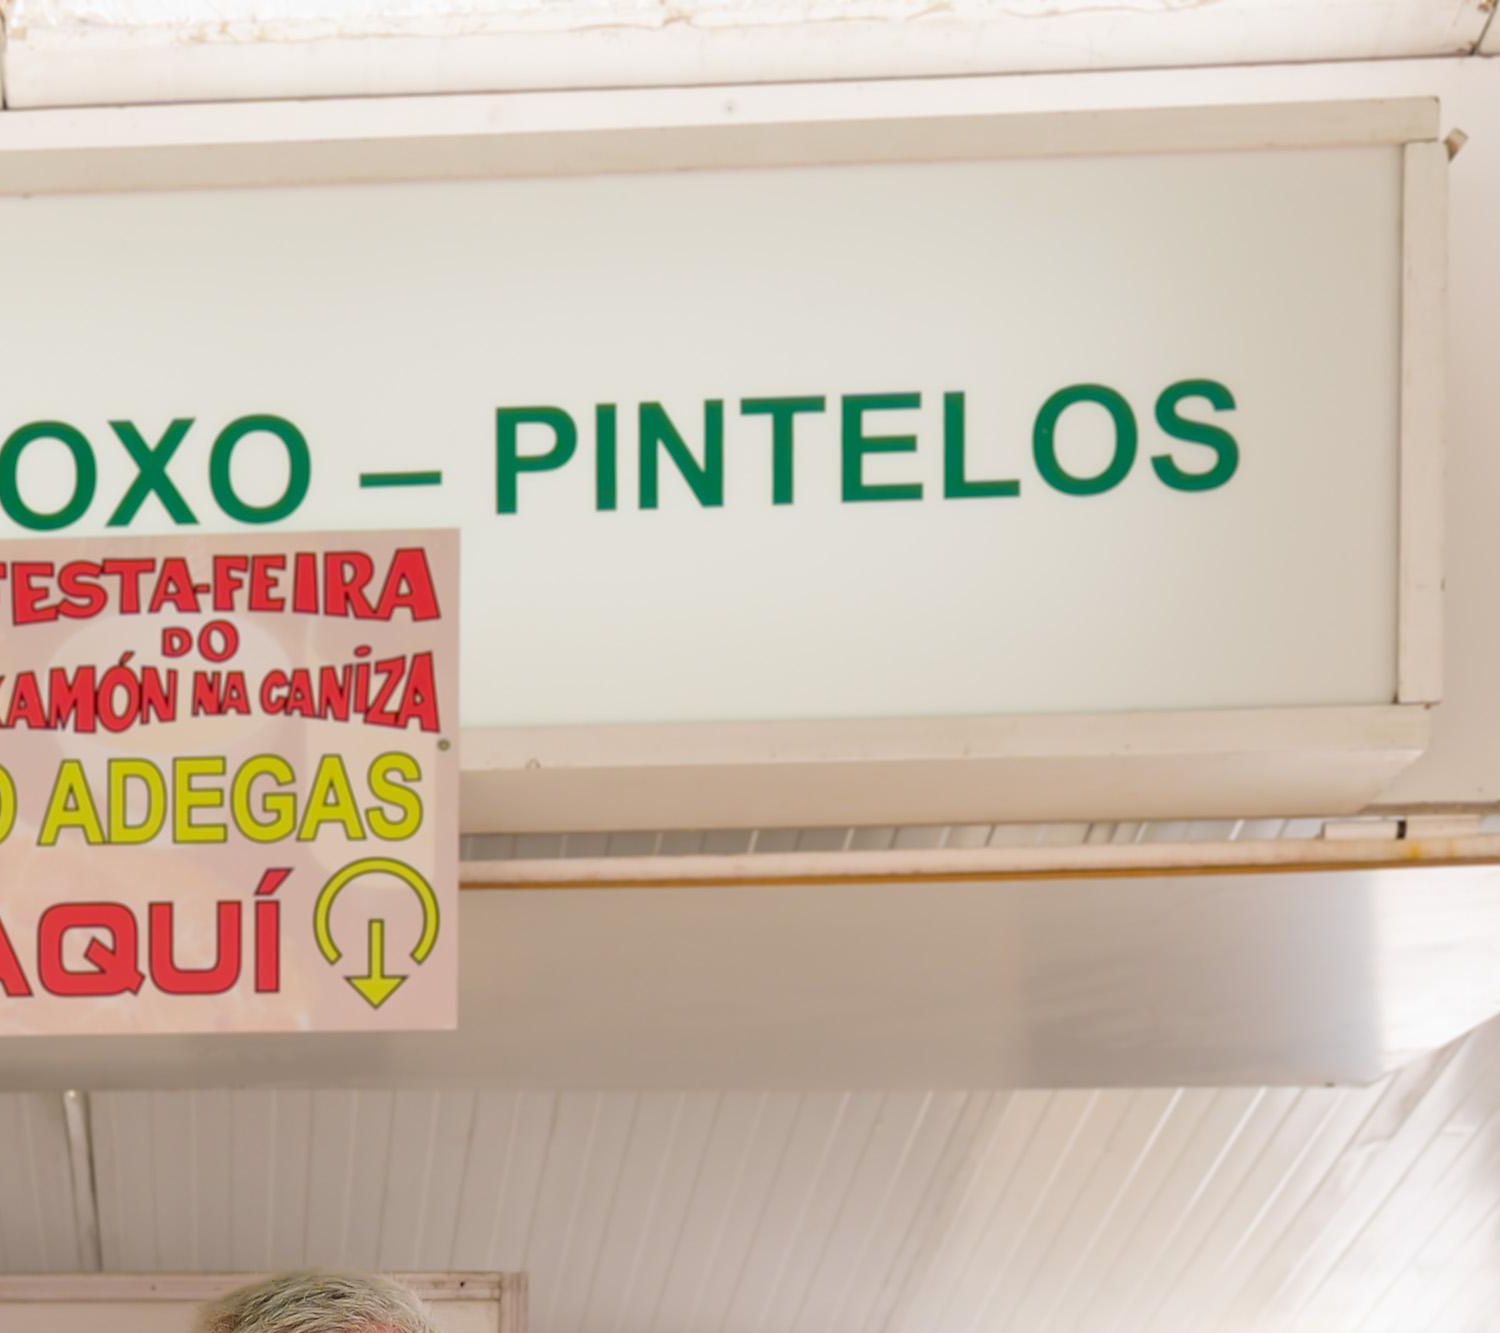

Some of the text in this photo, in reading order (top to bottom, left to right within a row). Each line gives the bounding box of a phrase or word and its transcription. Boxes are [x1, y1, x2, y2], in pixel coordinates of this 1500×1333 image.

[496, 379, 1239, 515] PINTELOS
[161, 619, 240, 664] DO
[190, 670, 252, 717] NA
[36, 751, 425, 848] ADEGAS
